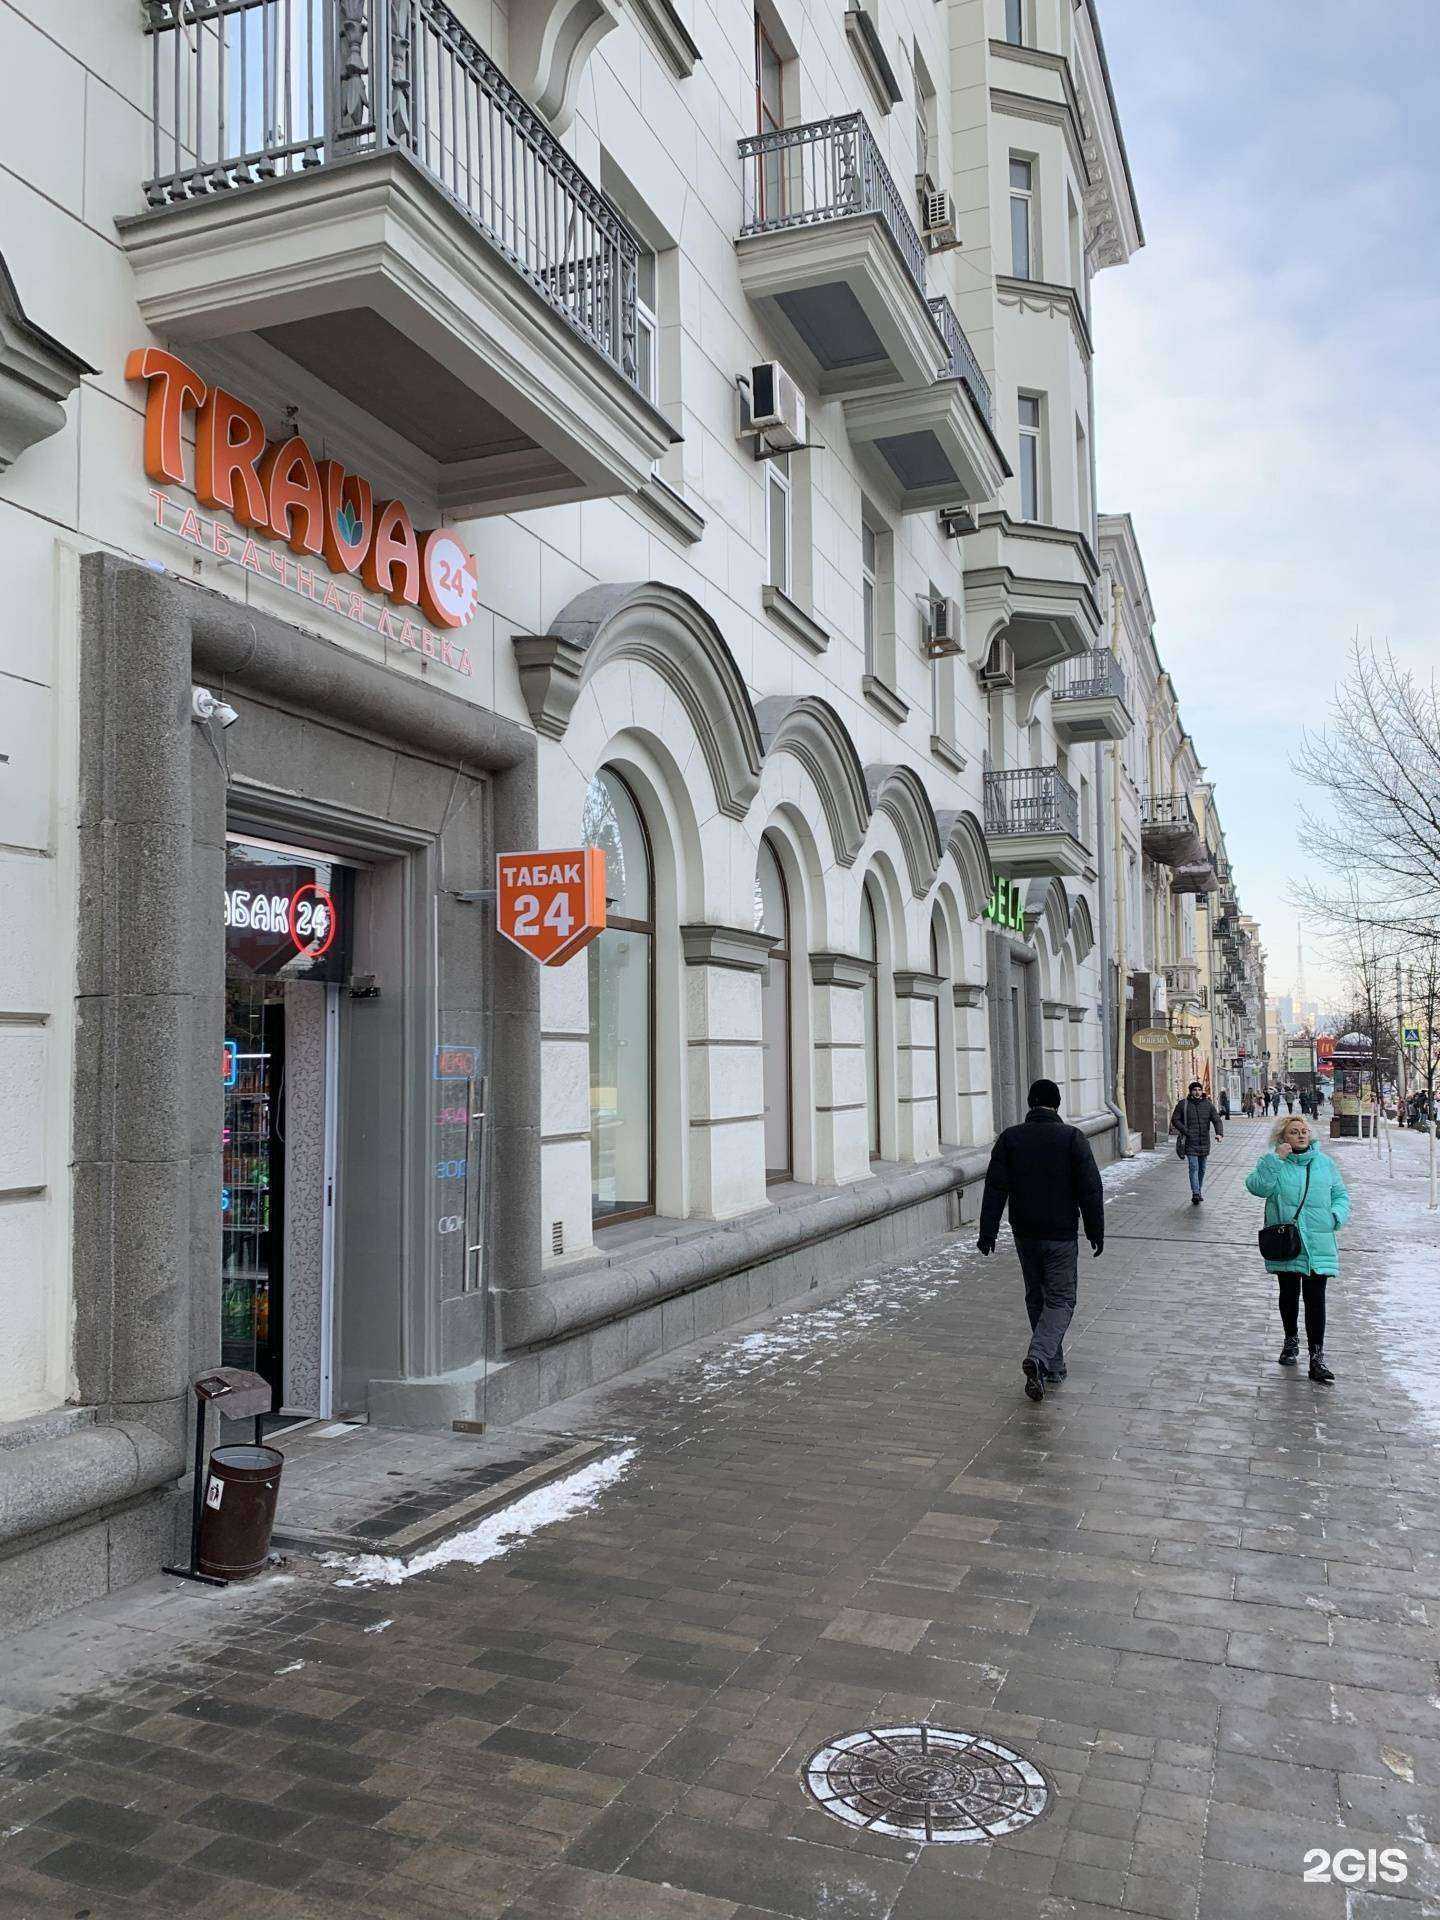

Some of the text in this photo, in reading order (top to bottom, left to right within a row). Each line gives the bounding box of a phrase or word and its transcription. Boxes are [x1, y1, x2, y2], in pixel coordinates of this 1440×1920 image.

[149, 488, 474, 678] ТАБАЧНАЯ ЛАВКА
[439, 560, 464, 598] 24
[503, 864, 581, 887] ТАБАК
[296, 901, 328, 938] 24
[514, 892, 575, 936] 24
